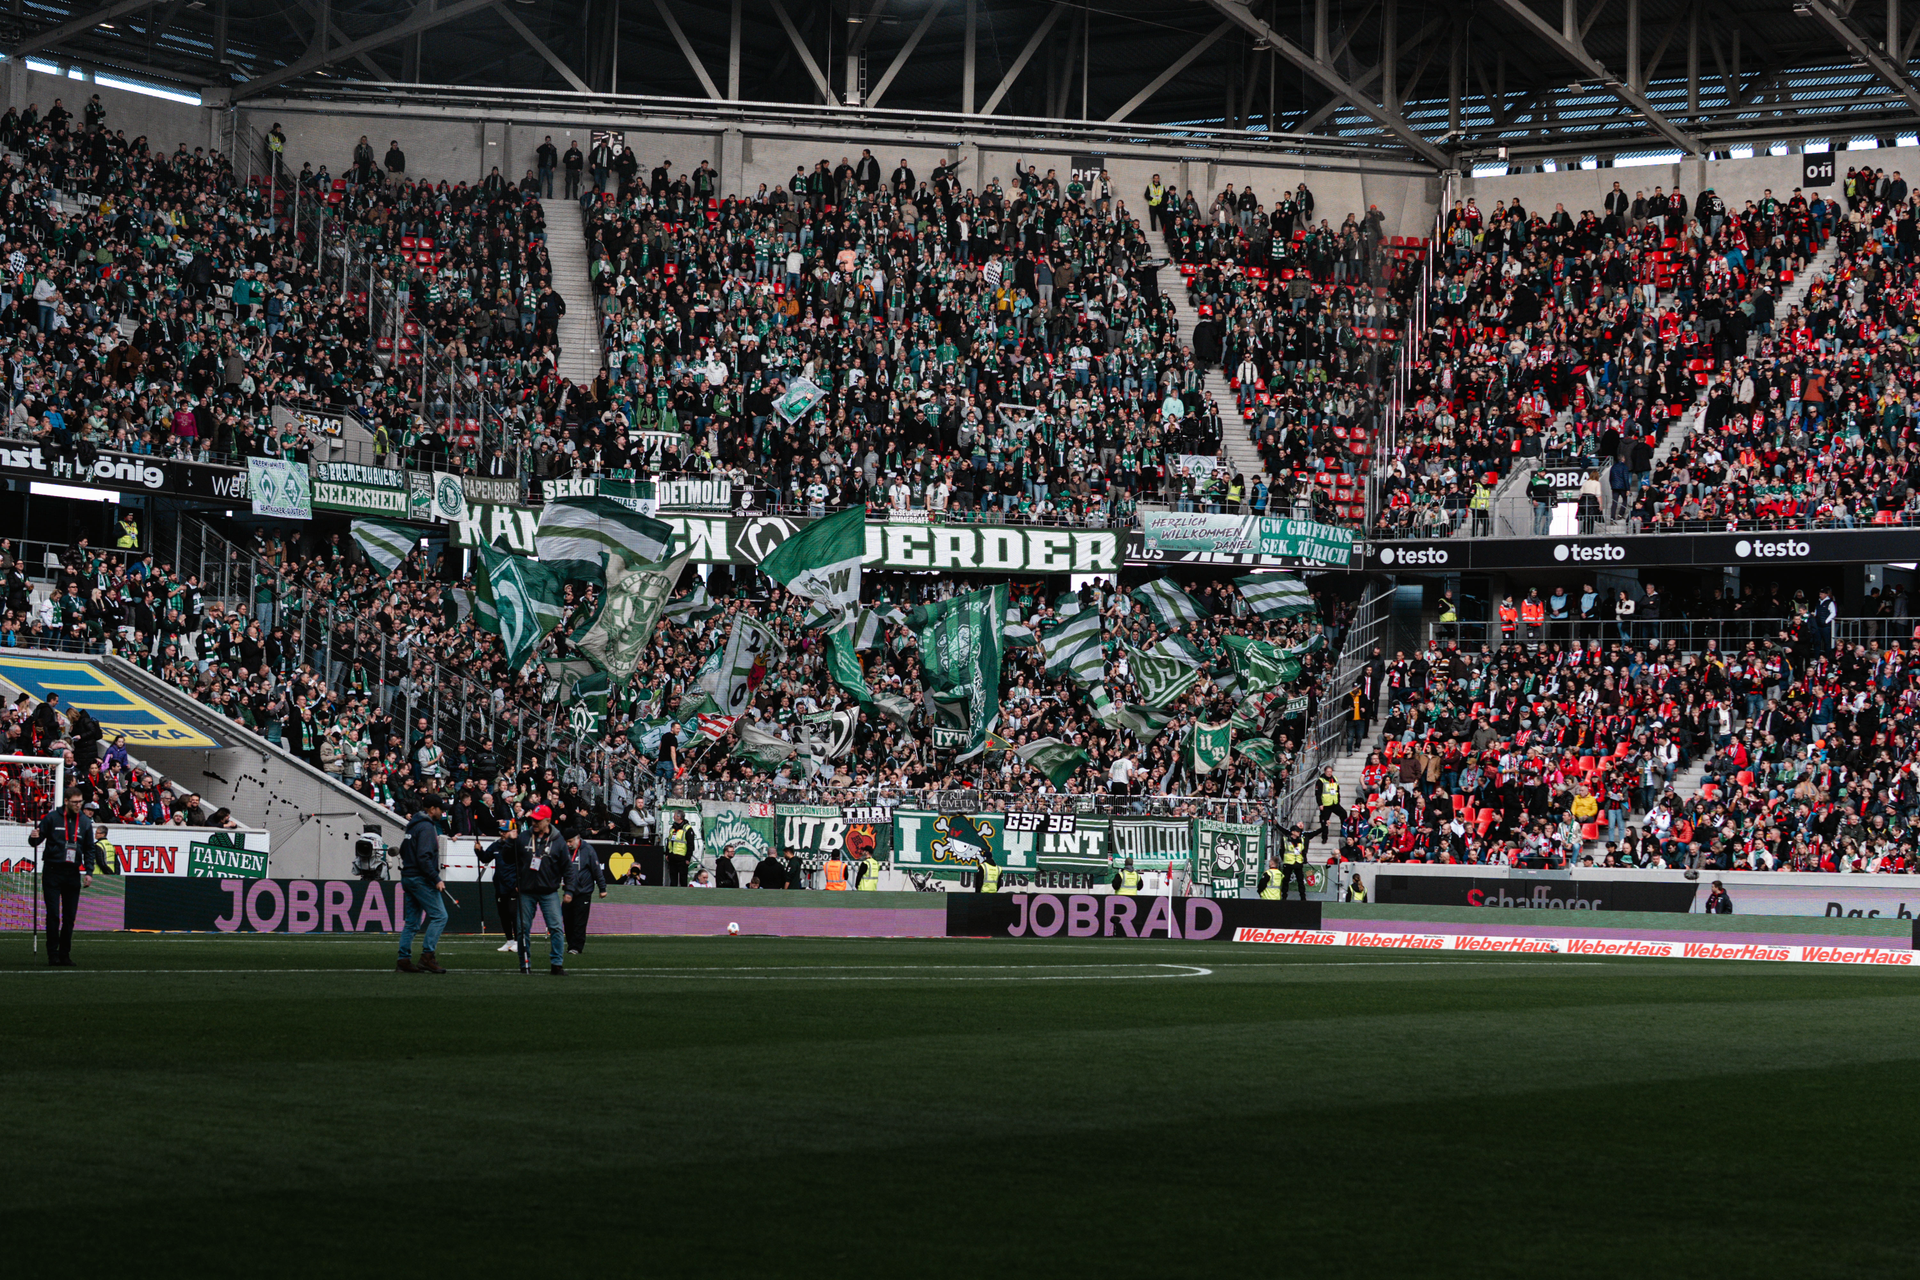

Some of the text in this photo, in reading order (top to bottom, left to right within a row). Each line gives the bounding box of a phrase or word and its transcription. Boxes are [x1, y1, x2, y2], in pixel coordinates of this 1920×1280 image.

[1806, 165, 1832, 178] 011
[329, 463, 397, 486] BREMERHAVEN
[313, 481, 407, 512] ISELERSHEIM
[463, 479, 520, 500] PAPENBURG
[660, 481, 731, 505] DETMOLD
[1261, 518, 1354, 543] GW GRIFFINS
[1296, 538, 1350, 564] ZÜRICH
[1396, 547, 1448, 564] testo
[1571, 542, 1625, 561] testo
[1753, 538, 1810, 557] testo
[940, 800, 975, 808] CIVETTA
[950, 792, 964, 800] RIP
[1005, 813, 1044, 830] GSF
[784, 816, 846, 851] UTB
[1043, 830, 1104, 855] INT
[193, 846, 264, 871] TANNEN
[1246, 841, 1258, 887] OYS
[1034, 870, 1094, 889] GEGEN
[1007, 893, 1223, 941] JOBRAD
[1239, 928, 1336, 945] WeberHaus
[1345, 932, 1444, 949] WeberHaus
[1454, 936, 1551, 952] WeberHaus
[1566, 939, 1672, 957] WeberHaus
[1683, 943, 1790, 961] WeberHaus
[1801, 947, 1913, 965] WeberHaus
